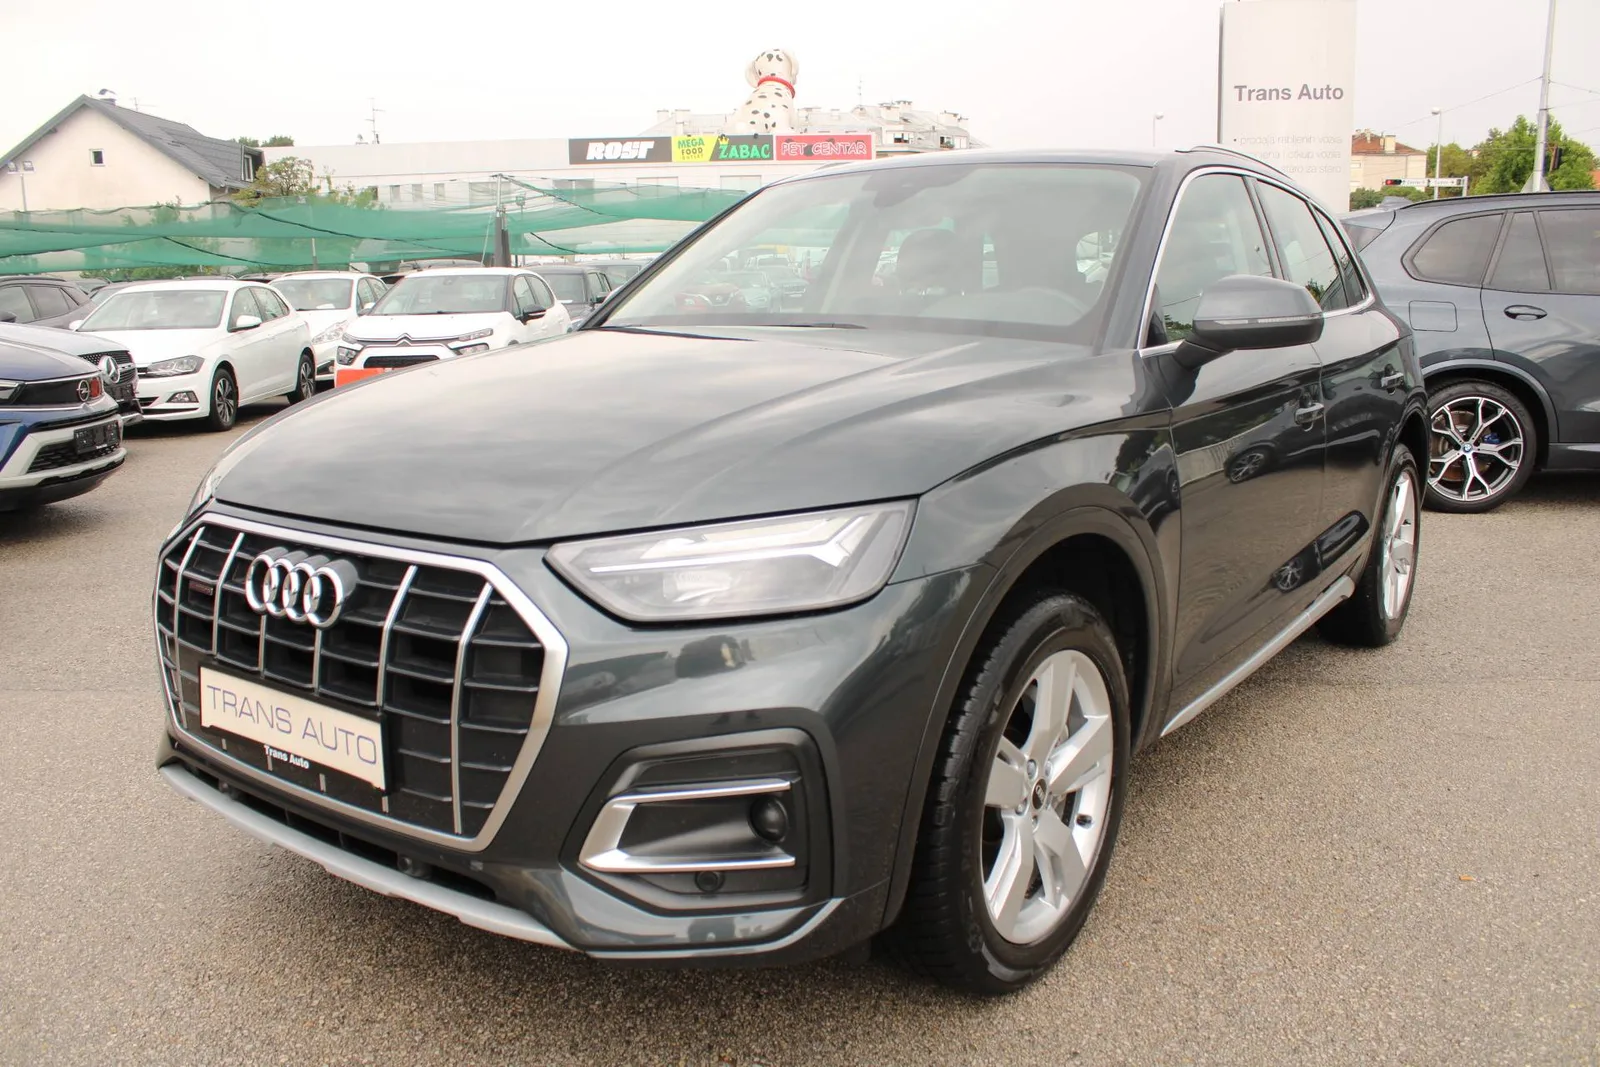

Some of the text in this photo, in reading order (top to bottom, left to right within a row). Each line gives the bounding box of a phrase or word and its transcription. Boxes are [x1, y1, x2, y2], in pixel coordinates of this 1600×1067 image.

[1233, 83, 1344, 101] Trans Auto
[586, 140, 655, 160] ROST
[677, 137, 705, 149] MEGA
[681, 147, 704, 156] FOOD
[781, 141, 867, 156] PET CENTAR
[206, 684, 378, 765] TRANS AUTO
[263, 744, 310, 769] Trans Auto
